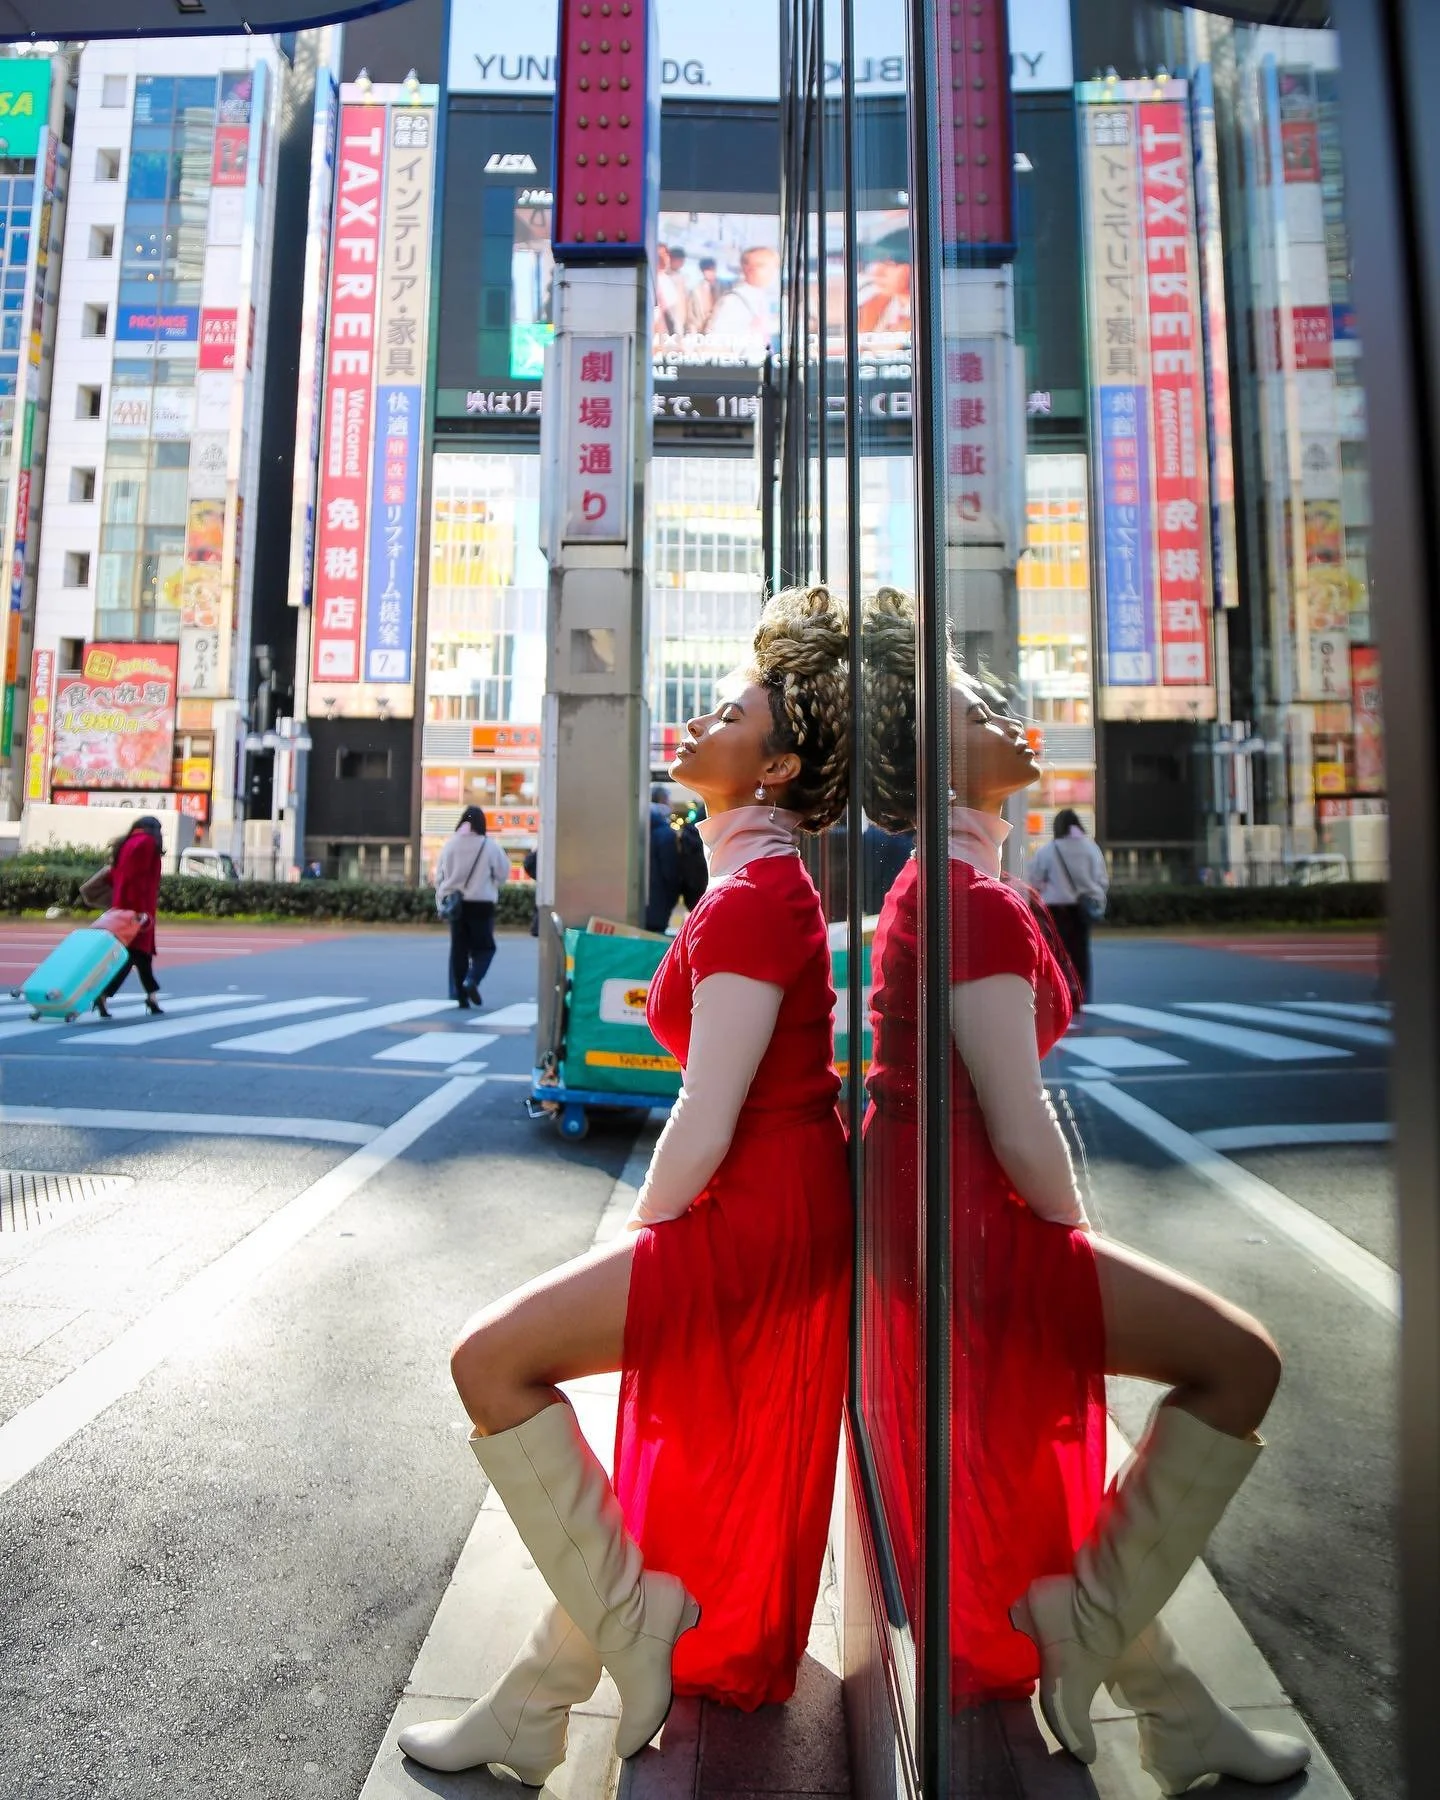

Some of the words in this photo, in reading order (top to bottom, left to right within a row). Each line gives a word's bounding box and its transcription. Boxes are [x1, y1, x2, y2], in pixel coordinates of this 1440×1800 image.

[579, 351, 614, 521] 劇場通り
[322, 496, 360, 630] 免税店
